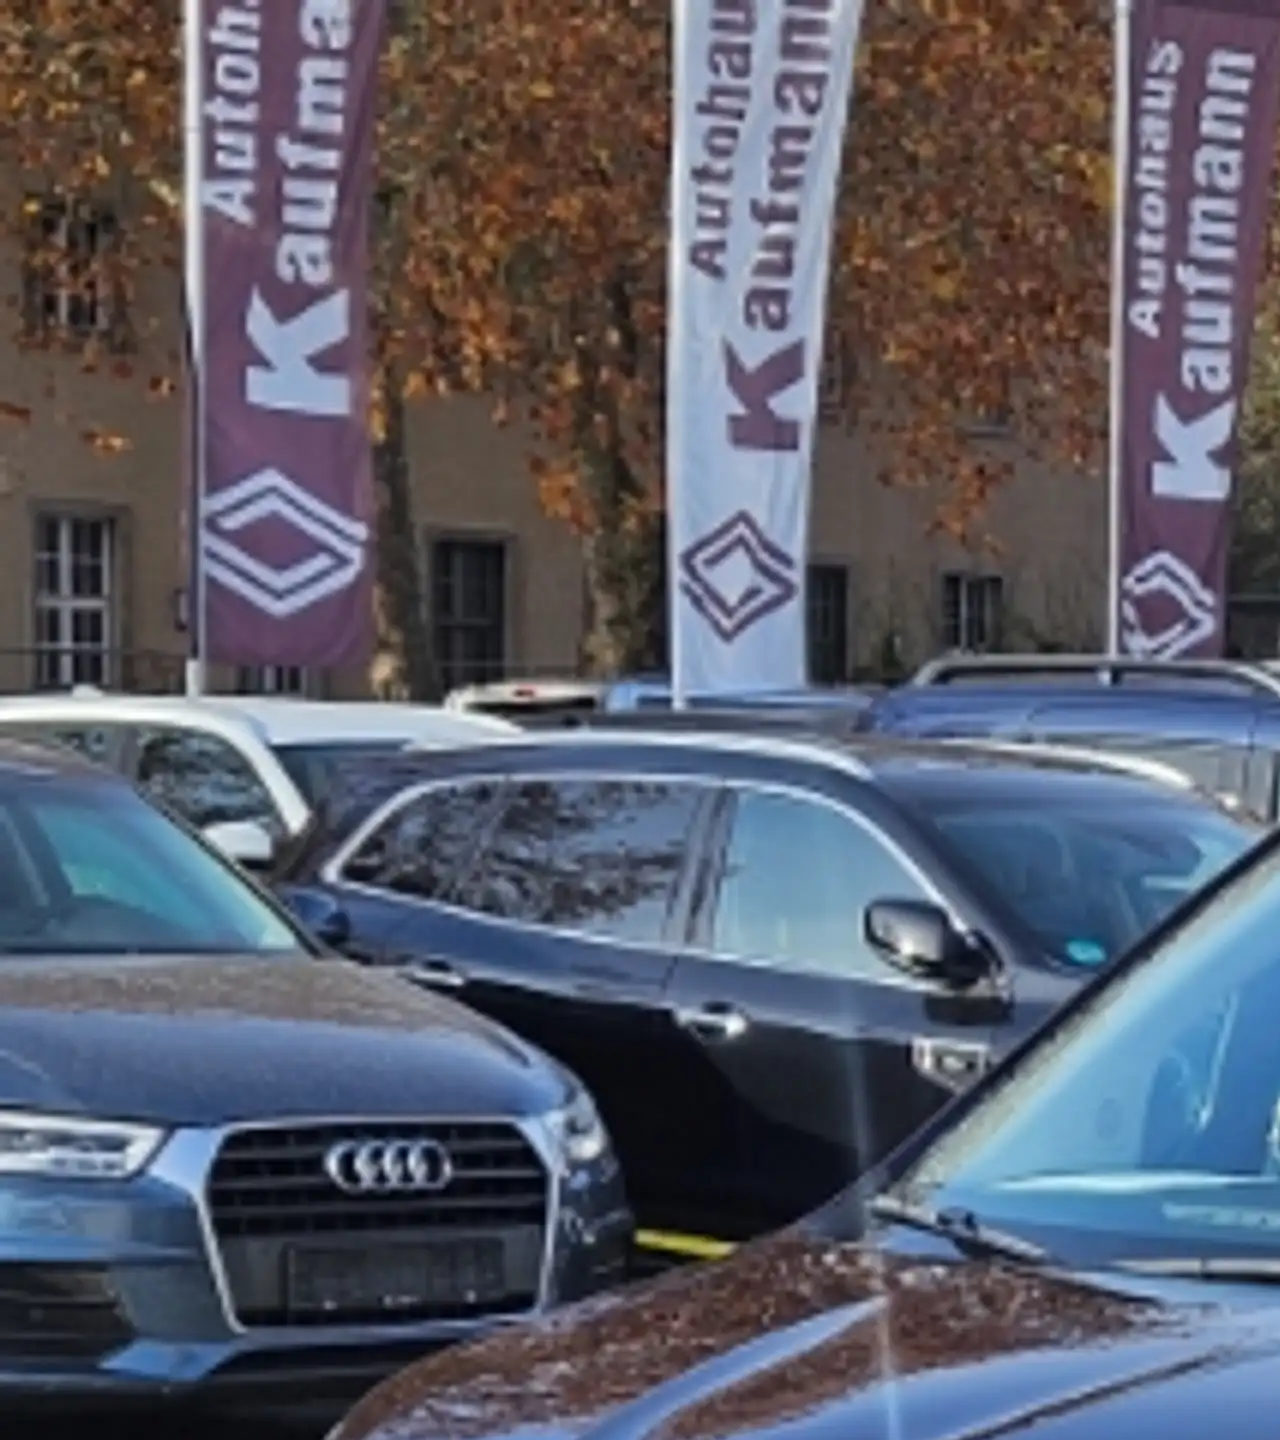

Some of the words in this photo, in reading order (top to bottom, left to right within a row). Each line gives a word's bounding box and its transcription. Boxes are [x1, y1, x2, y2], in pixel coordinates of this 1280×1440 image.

[201, 0, 261, 227] Autoh
[720, 0, 832, 451] Kaufman
[1129, 38, 1183, 338] Autohaus
[1151, 48, 1257, 500] Kaufmann
